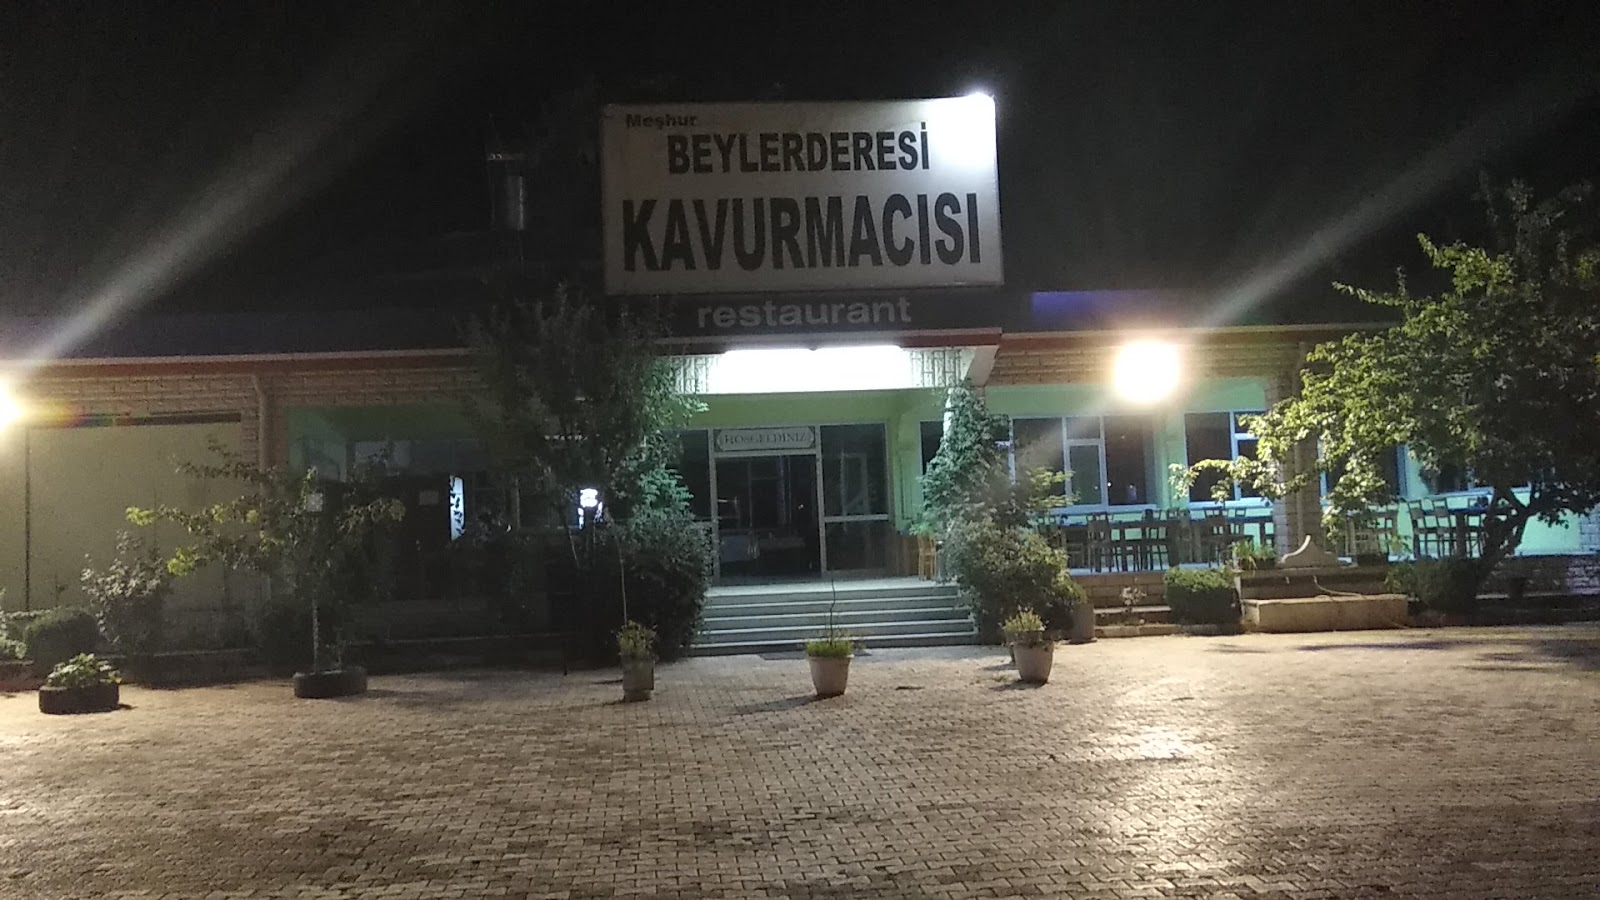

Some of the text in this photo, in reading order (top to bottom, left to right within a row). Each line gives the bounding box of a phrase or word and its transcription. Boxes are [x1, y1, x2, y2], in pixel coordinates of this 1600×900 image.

[626, 114, 699, 130] Meşhur
[667, 121, 930, 174] BEYLERDERESİ
[622, 193, 981, 272] KAVURMACISI
[698, 297, 911, 328] restaurant
